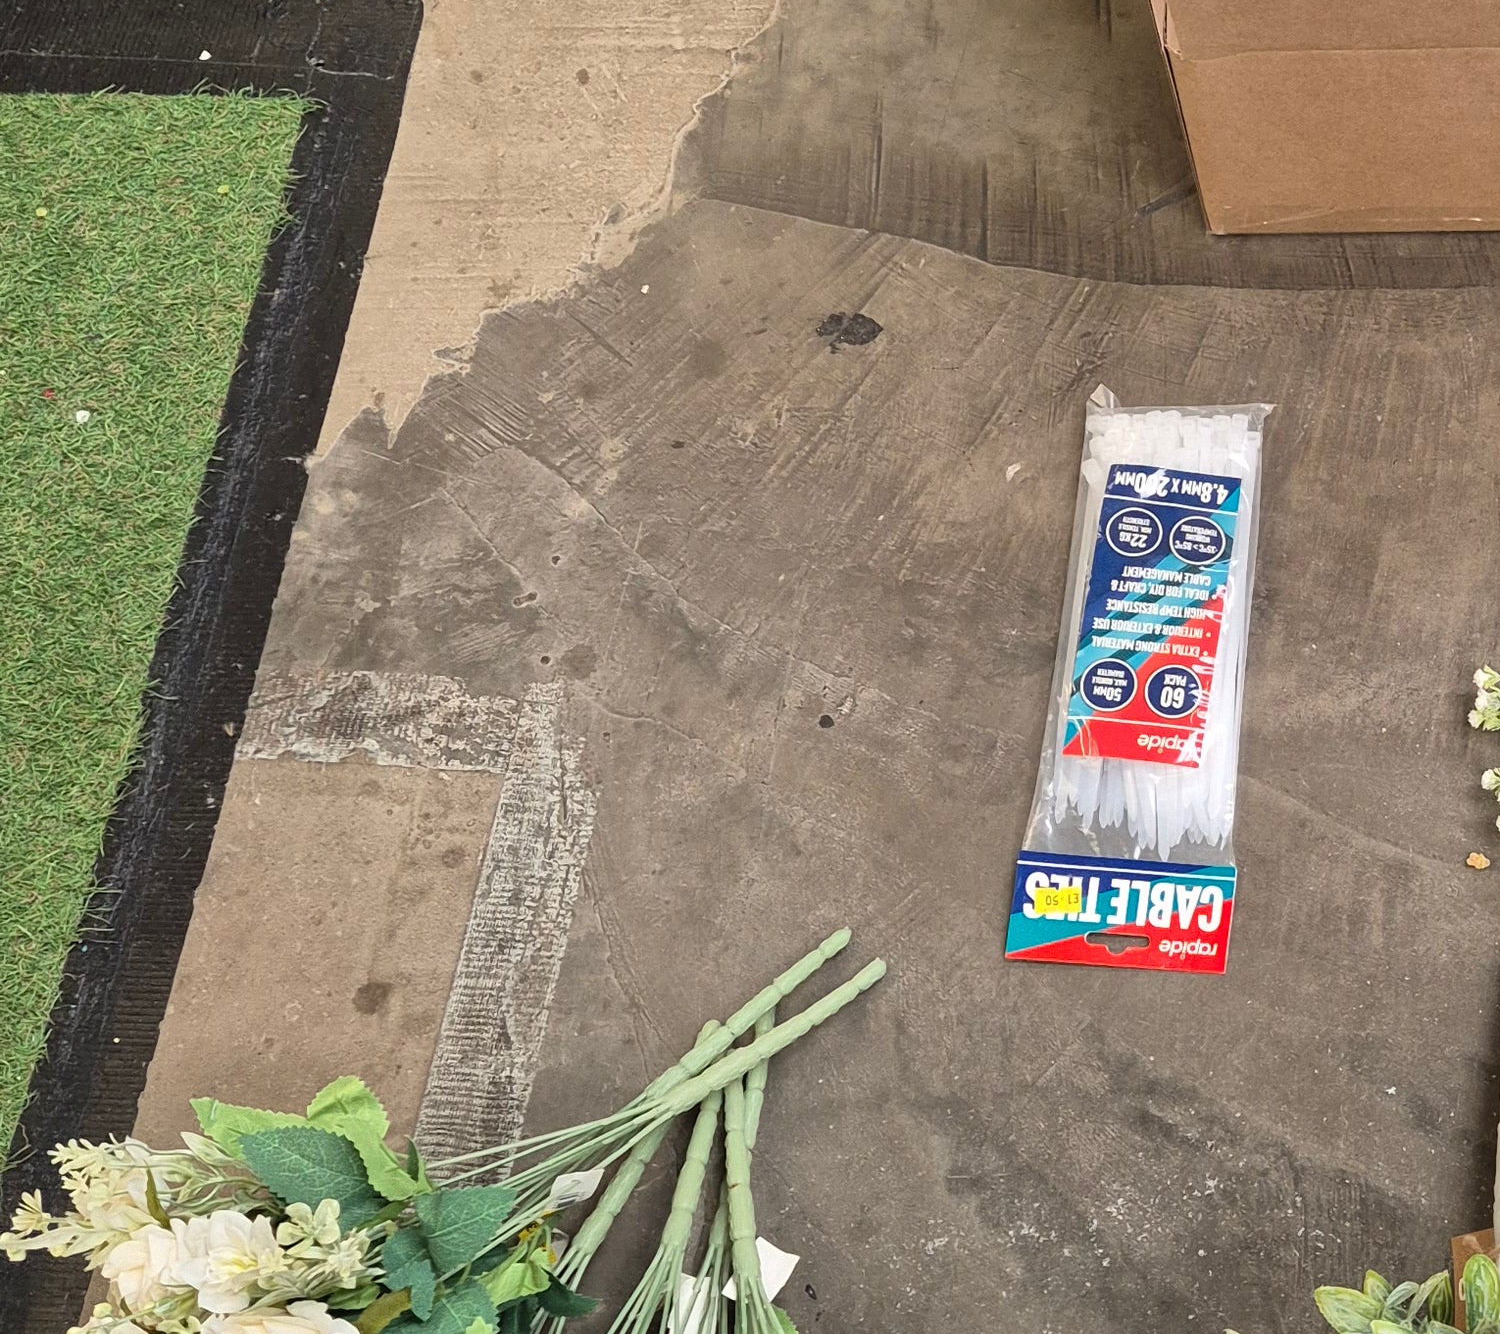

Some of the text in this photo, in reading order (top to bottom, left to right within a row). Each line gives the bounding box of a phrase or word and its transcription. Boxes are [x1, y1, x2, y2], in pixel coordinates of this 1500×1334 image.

[1181, 480, 1228, 505] 4.8MM
[1122, 566, 1211, 586] CABLE MANAGEMENT
[1111, 580, 1209, 600] IDEAL FOR DIY, CRAFT &
[1106, 599, 1206, 619] HIGH TEMP RESISTANCE
[1092, 617, 1203, 639] INTERIOR & EXTERIOR USE
[1092, 636, 1200, 656] EXTRA STRONG MATERIAL
[1163, 674, 1186, 687] PACK
[1160, 687, 1184, 709] 60
[1106, 878, 1223, 932] CABLE
[1159, 939, 1218, 959] rapide
